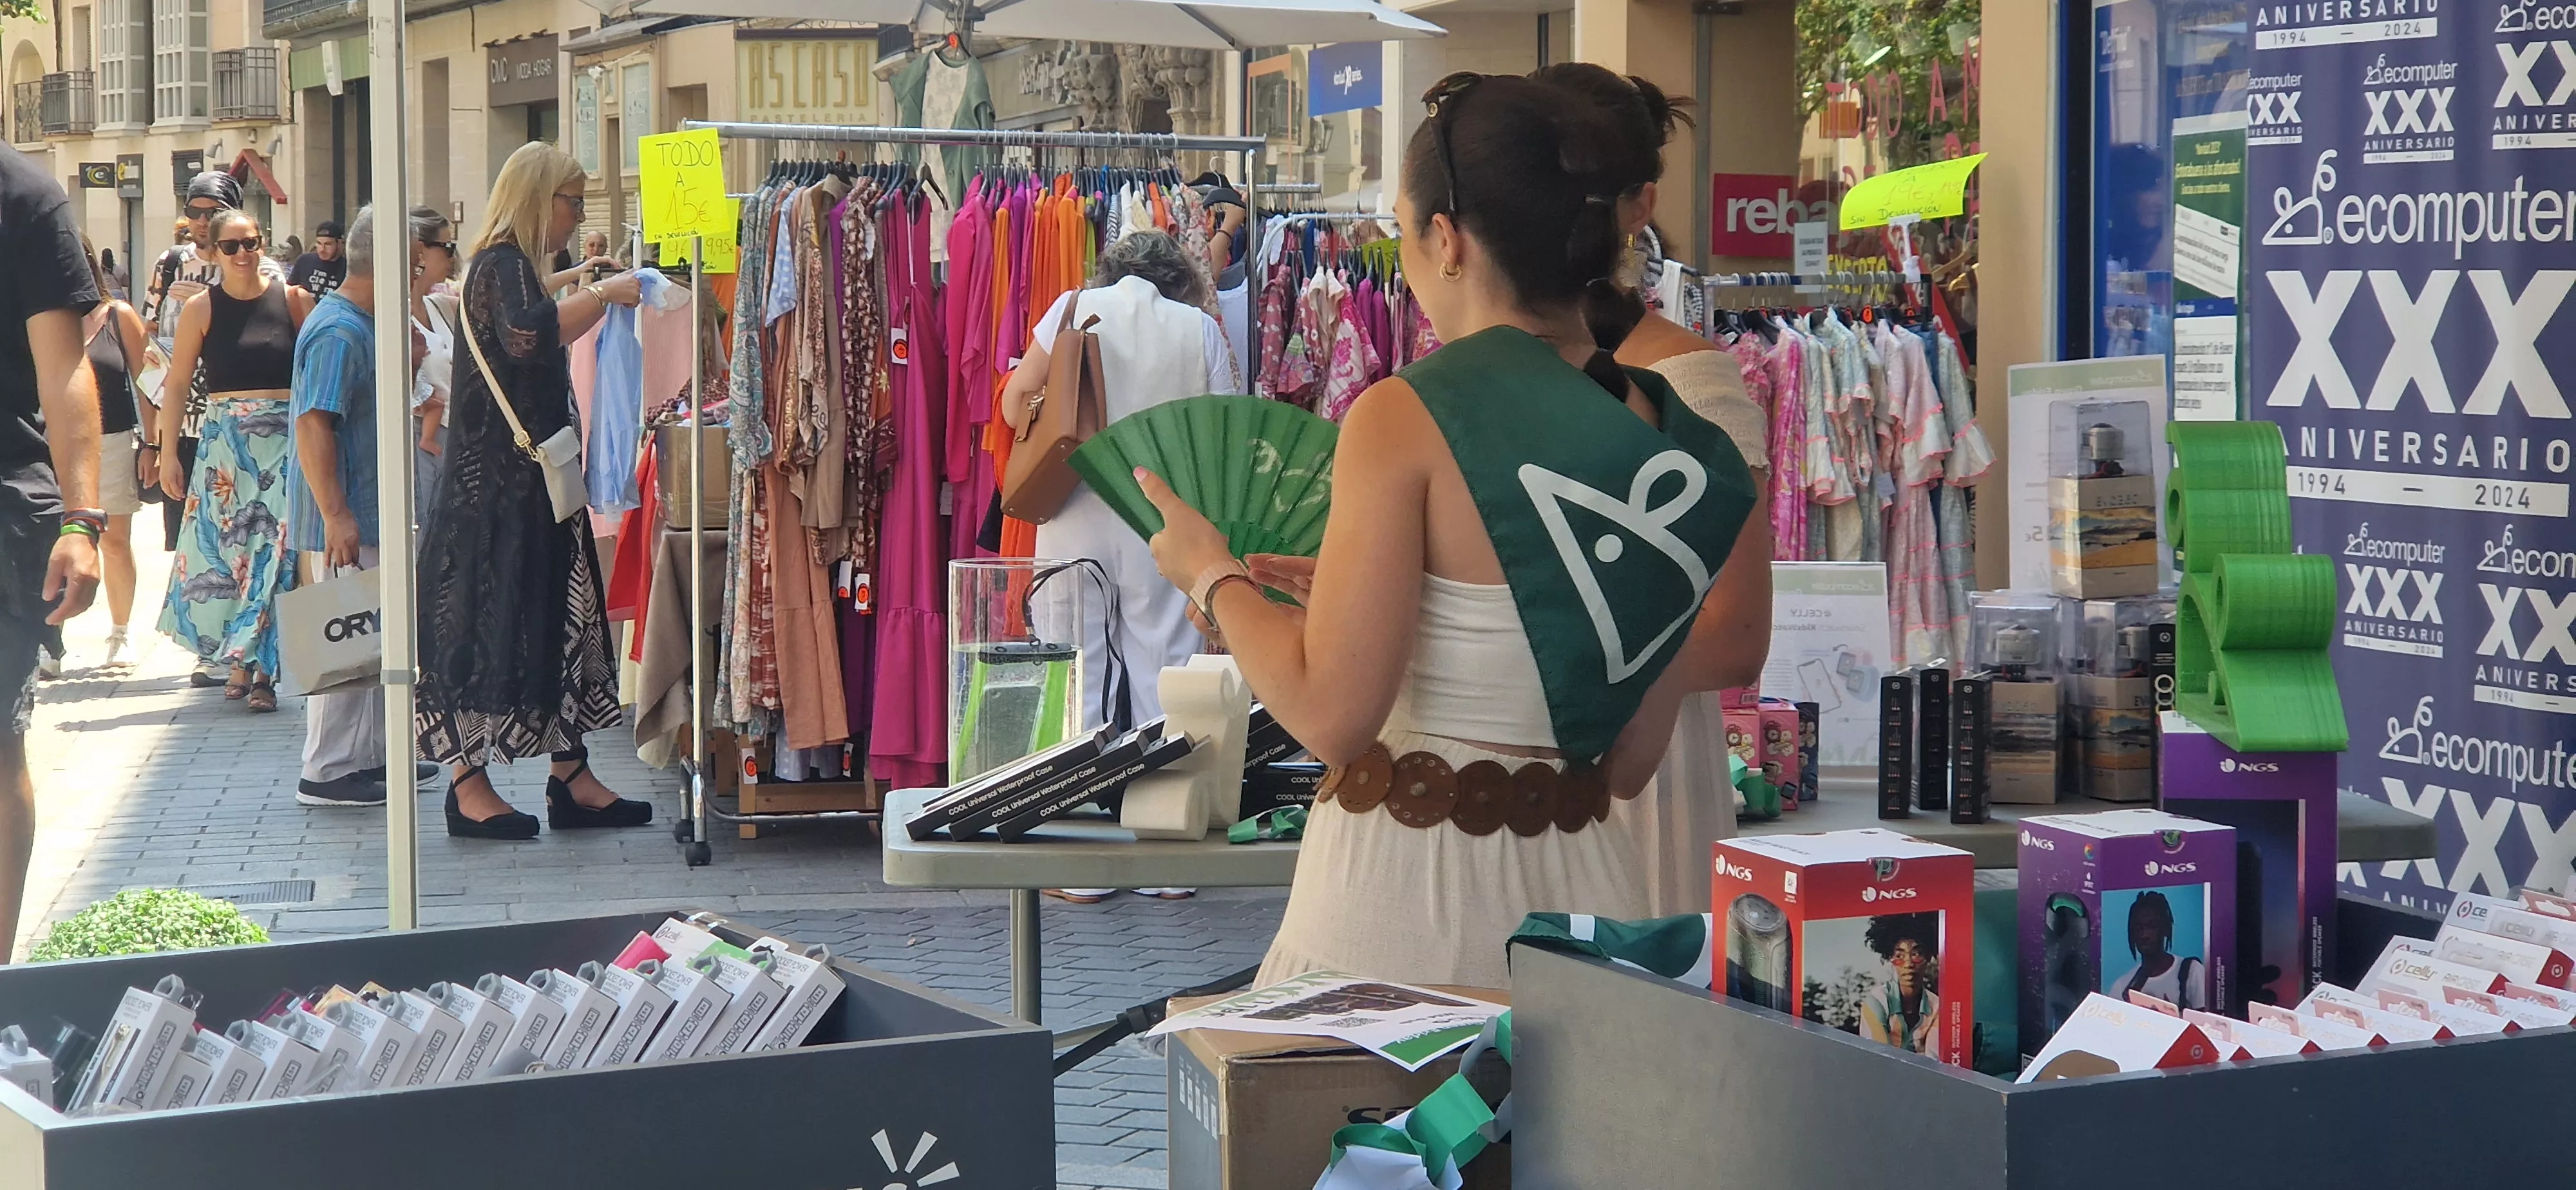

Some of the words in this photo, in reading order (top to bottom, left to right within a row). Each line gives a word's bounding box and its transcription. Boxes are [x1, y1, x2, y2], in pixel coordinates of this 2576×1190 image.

[2256, 0, 2438, 26] ANIVERSARIO
[2273, 31, 2307, 44] 1994
[2384, 23, 2421, 36] 2024
[748, 42, 869, 109] ASCASO
[2385, 61, 2458, 86] ecomputer
[1929, 55, 1947, 125] A
[750, 113, 866, 123] PASTELERIA
[2364, 86, 2456, 135] XXX
[2364, 137, 2454, 151] ANIVERSARIO
[2504, 135, 2532, 146] 1994
[656, 140, 714, 167] TODO
[676, 171, 685, 187] A
[2265, 270, 2576, 419] XXX
[2298, 471, 2346, 494] 1994
[2474, 484, 2531, 509] 2024
[2367, 539, 2445, 567] ecomputer
[2345, 563, 2444, 625] XXX
[2345, 619, 2444, 643] ANIVERSARIO
[2414, 645, 2437, 655] 2024
[2491, 689, 2514, 703] 1994
[1269, 744, 1286, 755] Case
[2238, 762, 2279, 773] NGS
[949, 804, 967, 815] COOL
[967, 789, 998, 808] Universal
[997, 772, 1036, 795] Waterproof
[1036, 764, 1054, 777] Case
[991, 806, 1011, 818] COOL
[1010, 791, 1041, 809] Universal
[1039, 774, 1079, 797] Waterproof
[1078, 766, 1097, 779] Case
[1039, 804, 1060, 817] COOL
[1059, 789, 1089, 808] Universal
[1088, 771, 1128, 793] Waterproof
[1126, 763, 1145, 775] Case
[2031, 836, 2055, 851] NGS
[1726, 863, 1753, 882] NGS
[2161, 861, 2197, 874] NGS
[1879, 887, 1917, 900] NGS
[732, 966, 749, 980] POWER
[791, 959, 809, 974] POWER
[617, 976, 634, 991] POWER
[675, 972, 692, 987] POWER
[509, 989, 526, 1003] POWER
[562, 983, 579, 997] POWER
[459, 997, 475, 1011] POWER
[359, 1014, 377, 1028] POWER
[308, 1024, 325, 1039] POWER
[260, 1035, 278, 1050] POWER
